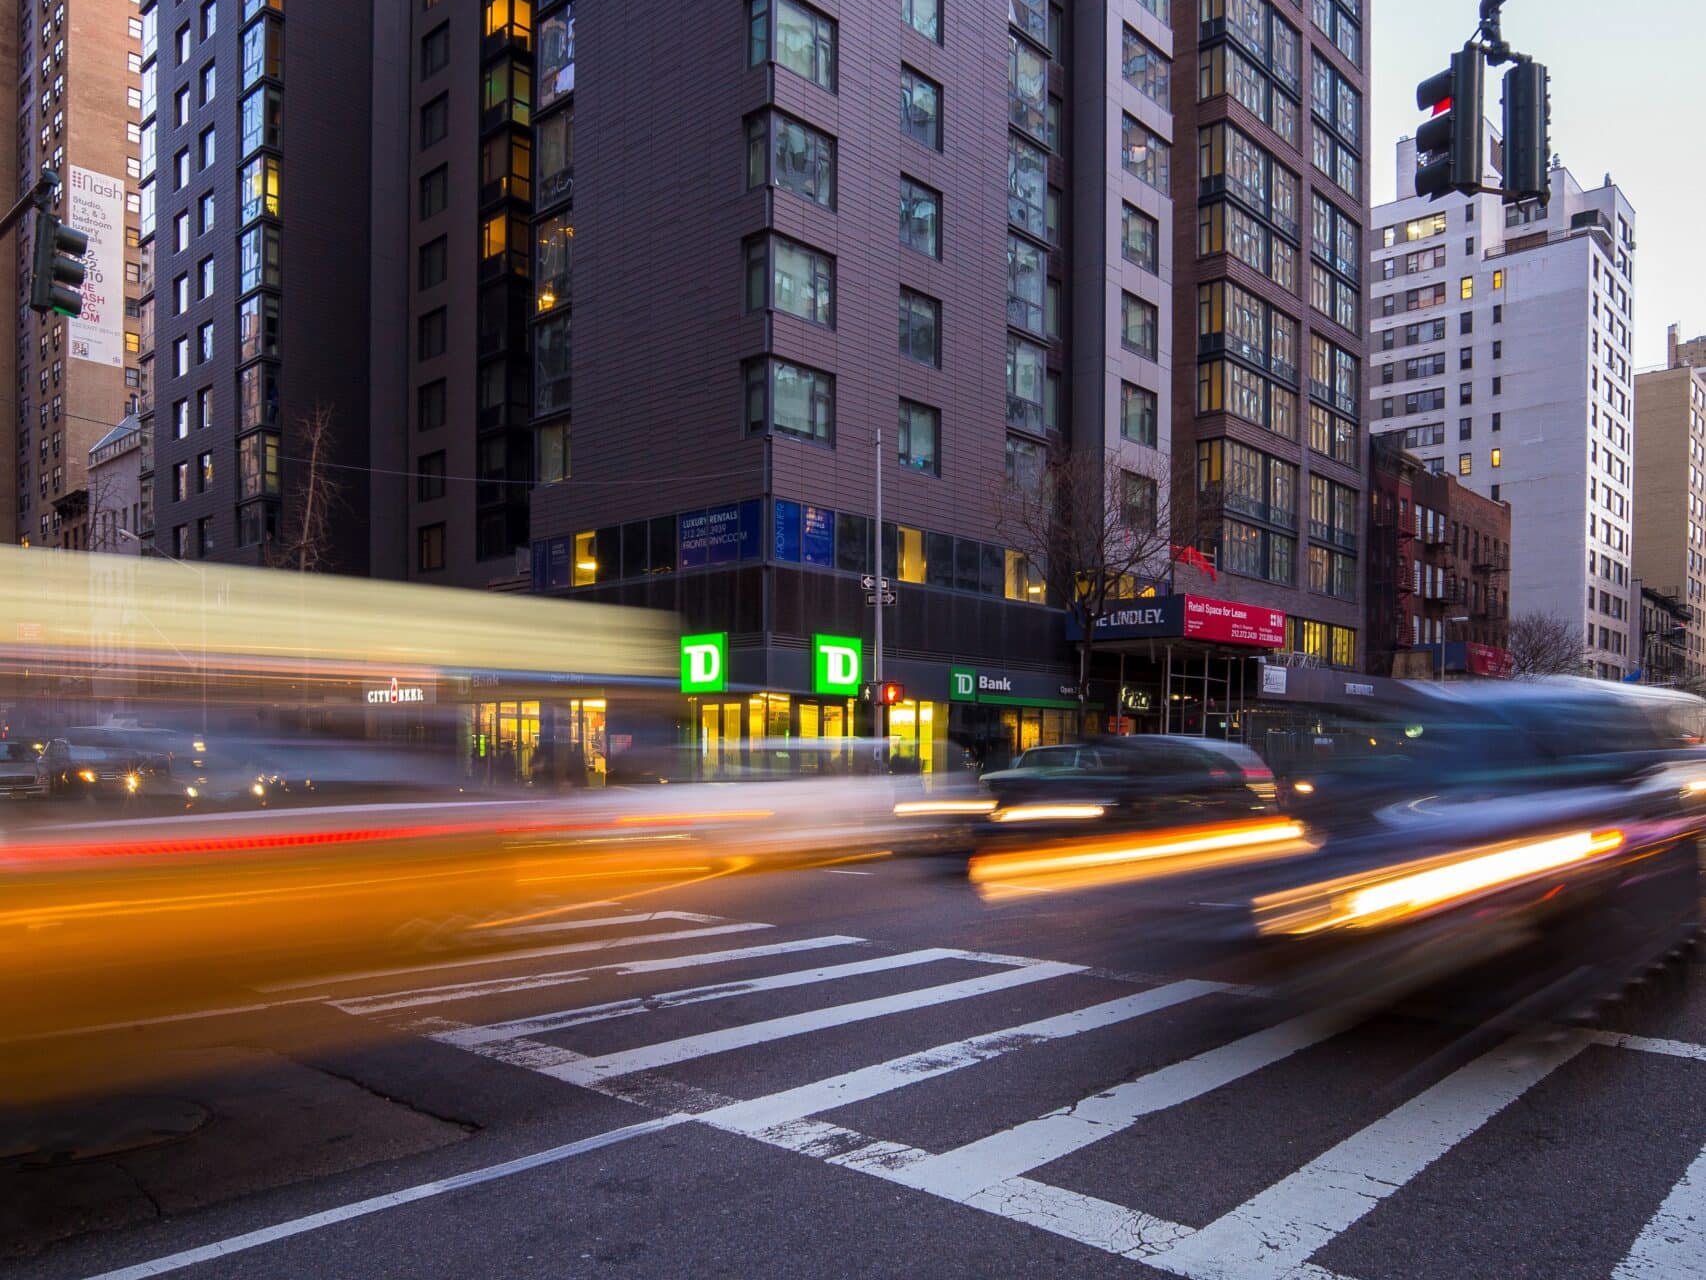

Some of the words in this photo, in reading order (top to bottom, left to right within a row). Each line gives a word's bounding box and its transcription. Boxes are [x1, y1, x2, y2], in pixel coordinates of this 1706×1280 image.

[72, 213, 112, 230] bedroom
[101, 212, 106, 220] 3
[81, 282, 95, 293] HE
[81, 292, 105, 305] ASH
[81, 302, 99, 314] YC.
[81, 311, 100, 324] OM
[709, 510, 738, 524] RENTALS
[775, 503, 785, 560] FRONTIER
[1188, 601, 1205, 613] Retail
[1205, 603, 1222, 616] Space
[1222, 607, 1231, 617] for
[1231, 608, 1247, 619] Lease
[684, 644, 720, 683] TD
[820, 645, 858, 685] TD
[954, 673, 973, 695] TD
[978, 675, 1011, 691] Bank
[367, 690, 390, 703] CITY
[398, 688, 424, 702] BEER
